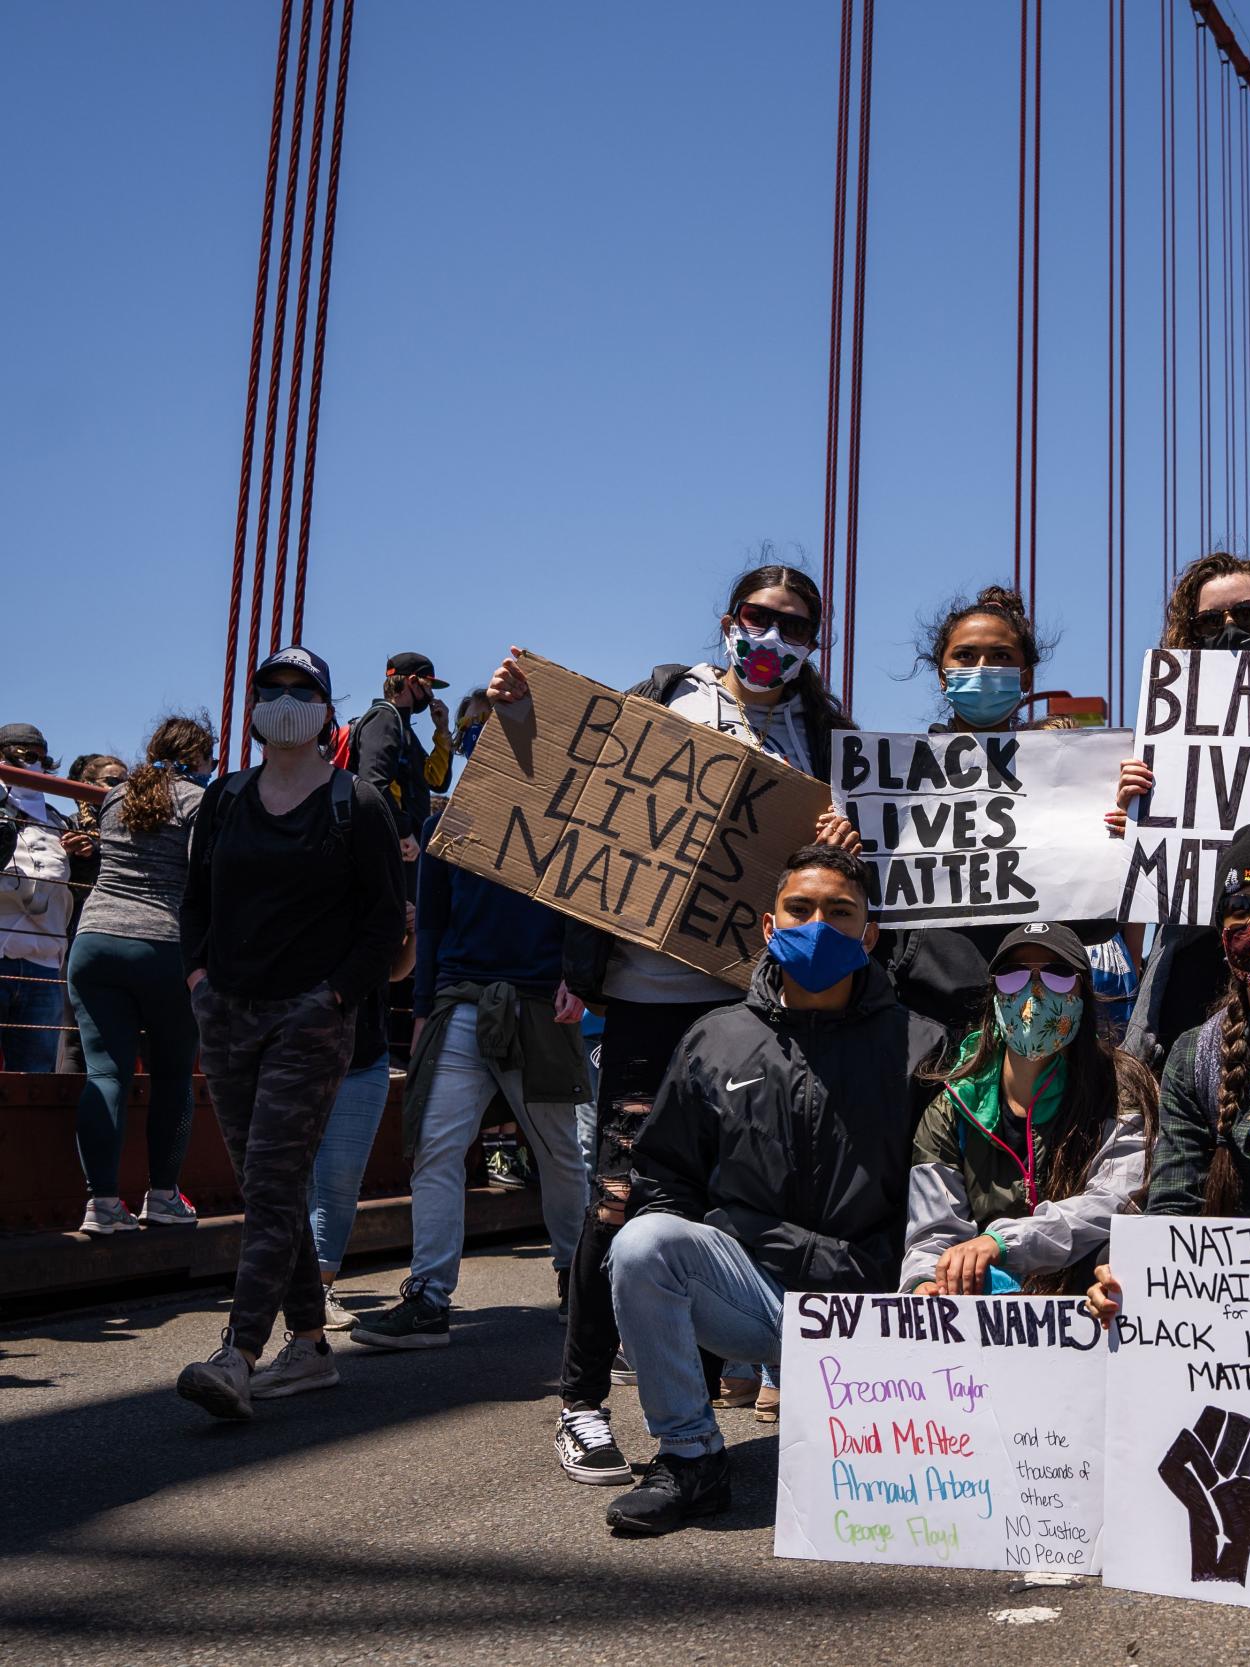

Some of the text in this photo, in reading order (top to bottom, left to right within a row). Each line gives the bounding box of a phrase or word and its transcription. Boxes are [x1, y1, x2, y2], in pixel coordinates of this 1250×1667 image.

[567, 695, 778, 833] BLACK
[841, 735, 1023, 791] BLACK
[544, 768, 748, 882] LIVES
[846, 800, 1016, 853] LIVES
[495, 806, 758, 961] MATTER
[799, 1294, 1101, 1351] SAY THEIR NAMES
[1115, 1314, 1216, 1352] BLACK
[1222, 1304, 1248, 1320] for
[819, 1356, 990, 1412] Breonna Taylor
[829, 1417, 882, 1458] David
[1013, 1430, 1070, 1448] and the
[832, 1460, 918, 1505] Ahmaud
[1016, 1461, 1090, 1479] thousands of
[1021, 1492, 1063, 1509] others
[834, 1510, 959, 1559] George Floyd
[1005, 1516, 1090, 1543] NO Justice
[1006, 1548, 1084, 1566] NO Peace
